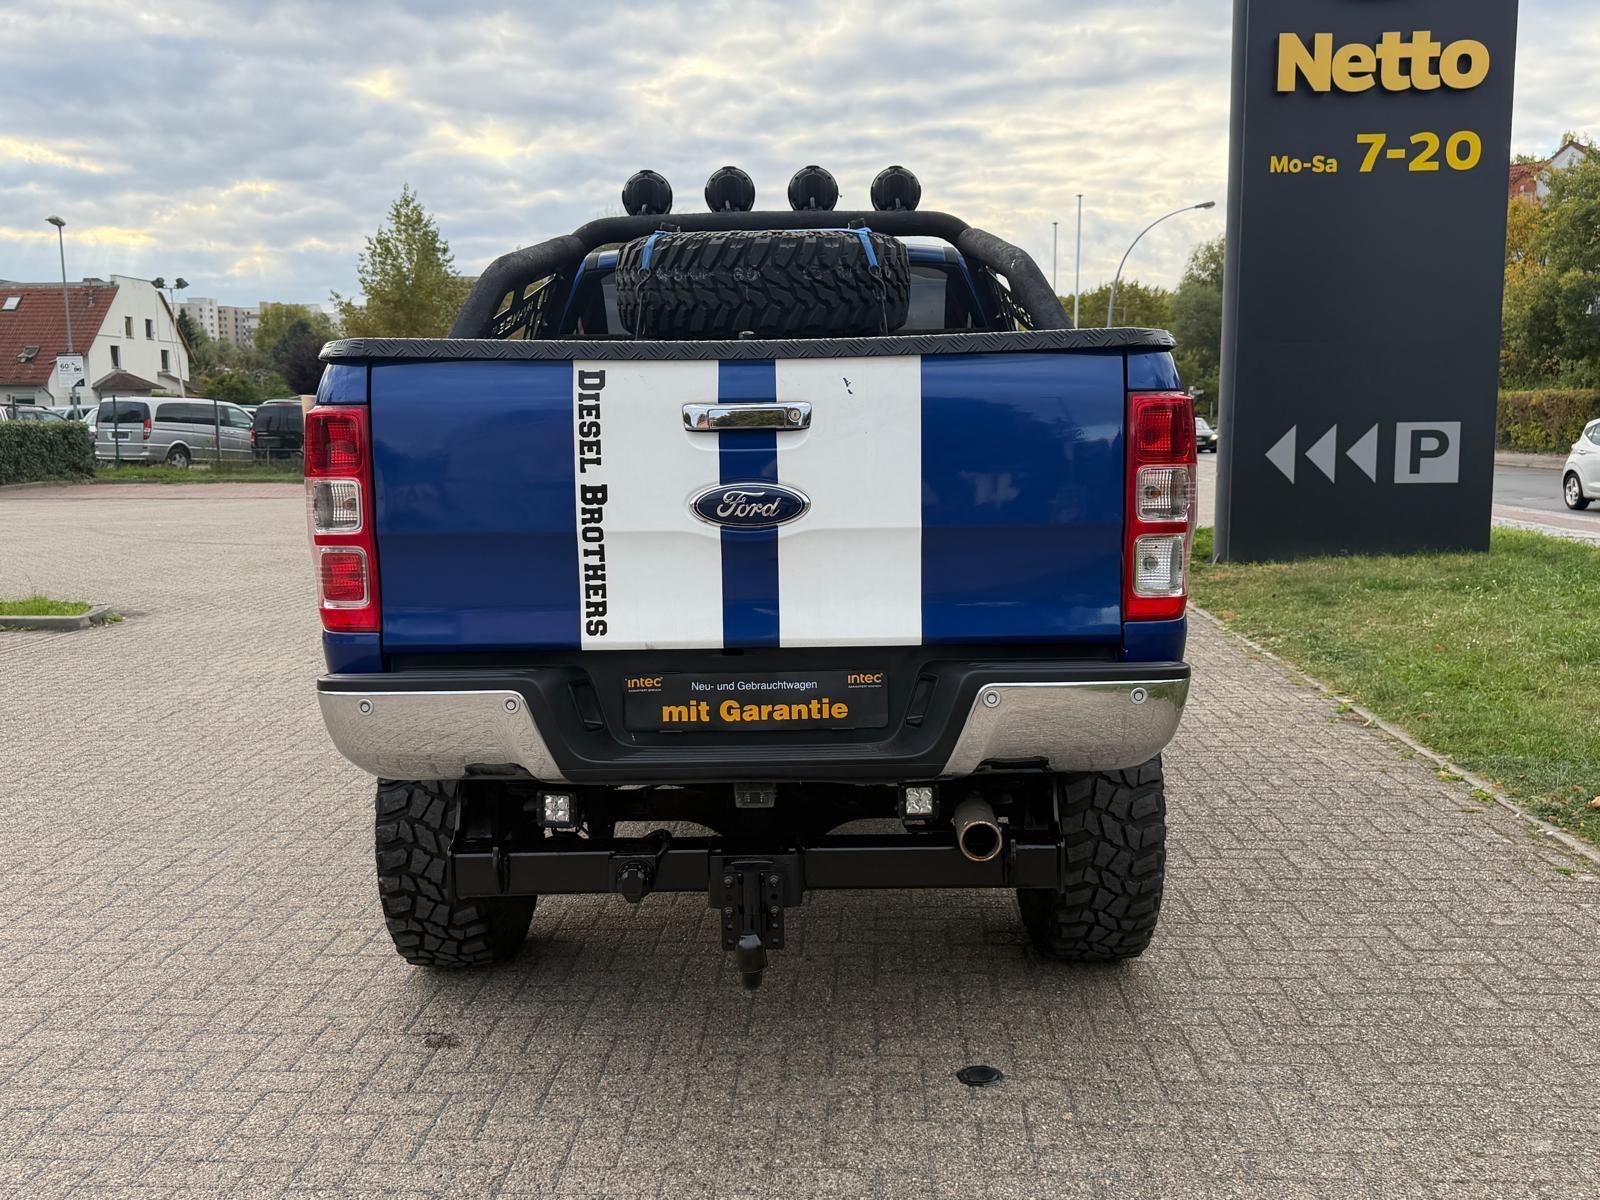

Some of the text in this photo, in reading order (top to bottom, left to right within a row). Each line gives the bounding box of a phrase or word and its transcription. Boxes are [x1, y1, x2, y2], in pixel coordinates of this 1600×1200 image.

[1276, 30, 1491, 93] Netto
[1269, 130, 1482, 174] Mo-Sa 7-20
[1409, 430, 1450, 474] P
[578, 369, 608, 638] DIESEL BROTHERS
[716, 490, 781, 518] Ford
[627, 677, 662, 688] intec
[691, 680, 818, 692] Neu- und Gebrauchtwagen
[847, 673, 882, 684] intec
[662, 698, 849, 722] mit Garantie
